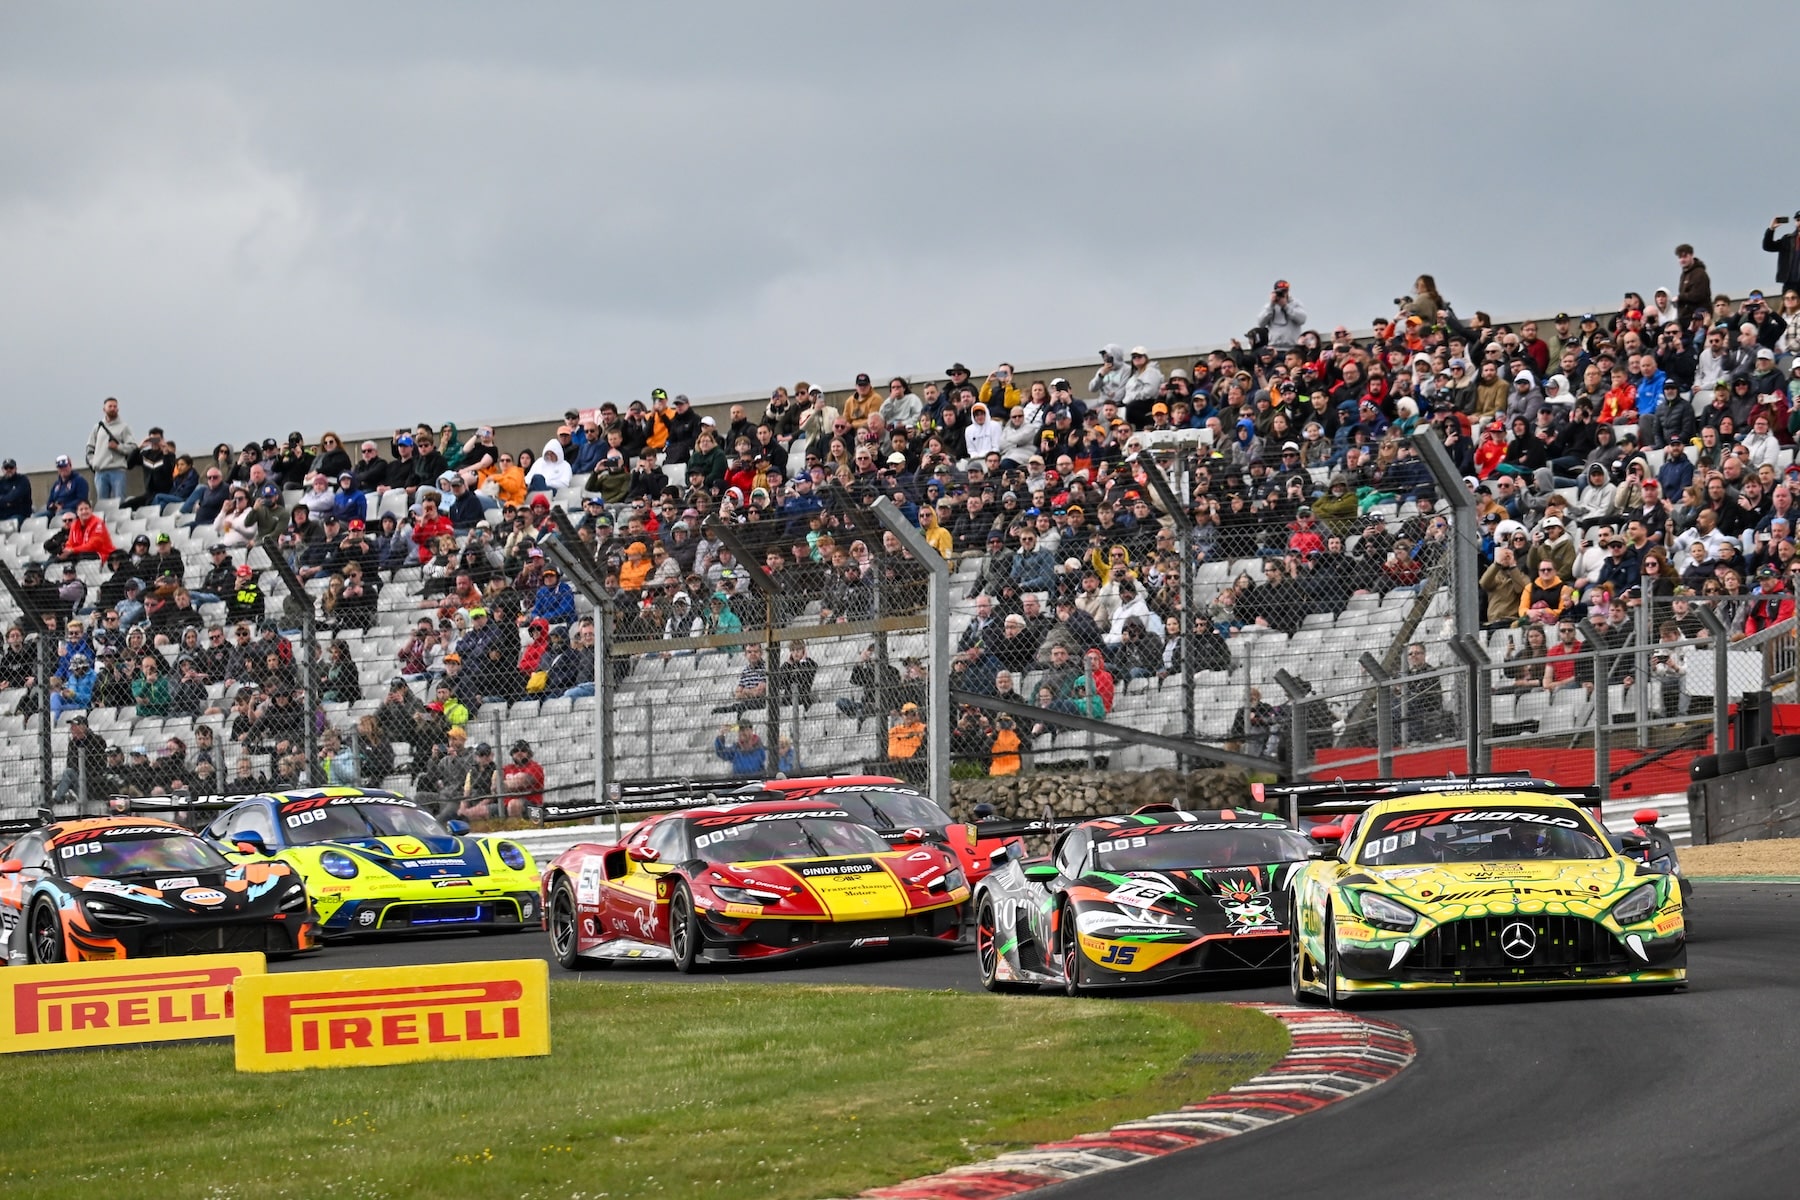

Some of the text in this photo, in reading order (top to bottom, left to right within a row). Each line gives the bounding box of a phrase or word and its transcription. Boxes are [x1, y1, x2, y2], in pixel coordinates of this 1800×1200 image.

[286, 808, 328, 828] 008
[695, 826, 739, 848] 004
[1097, 836, 1147, 853] 003
[60, 841, 103, 859] 005
[803, 864, 873, 876] GINION GROUP
[185, 892, 222, 900] Gulf
[820, 884, 893, 893] Francorchamps
[14, 967, 242, 1035] PIRELLI
[263, 980, 523, 1053] PIRELLI
